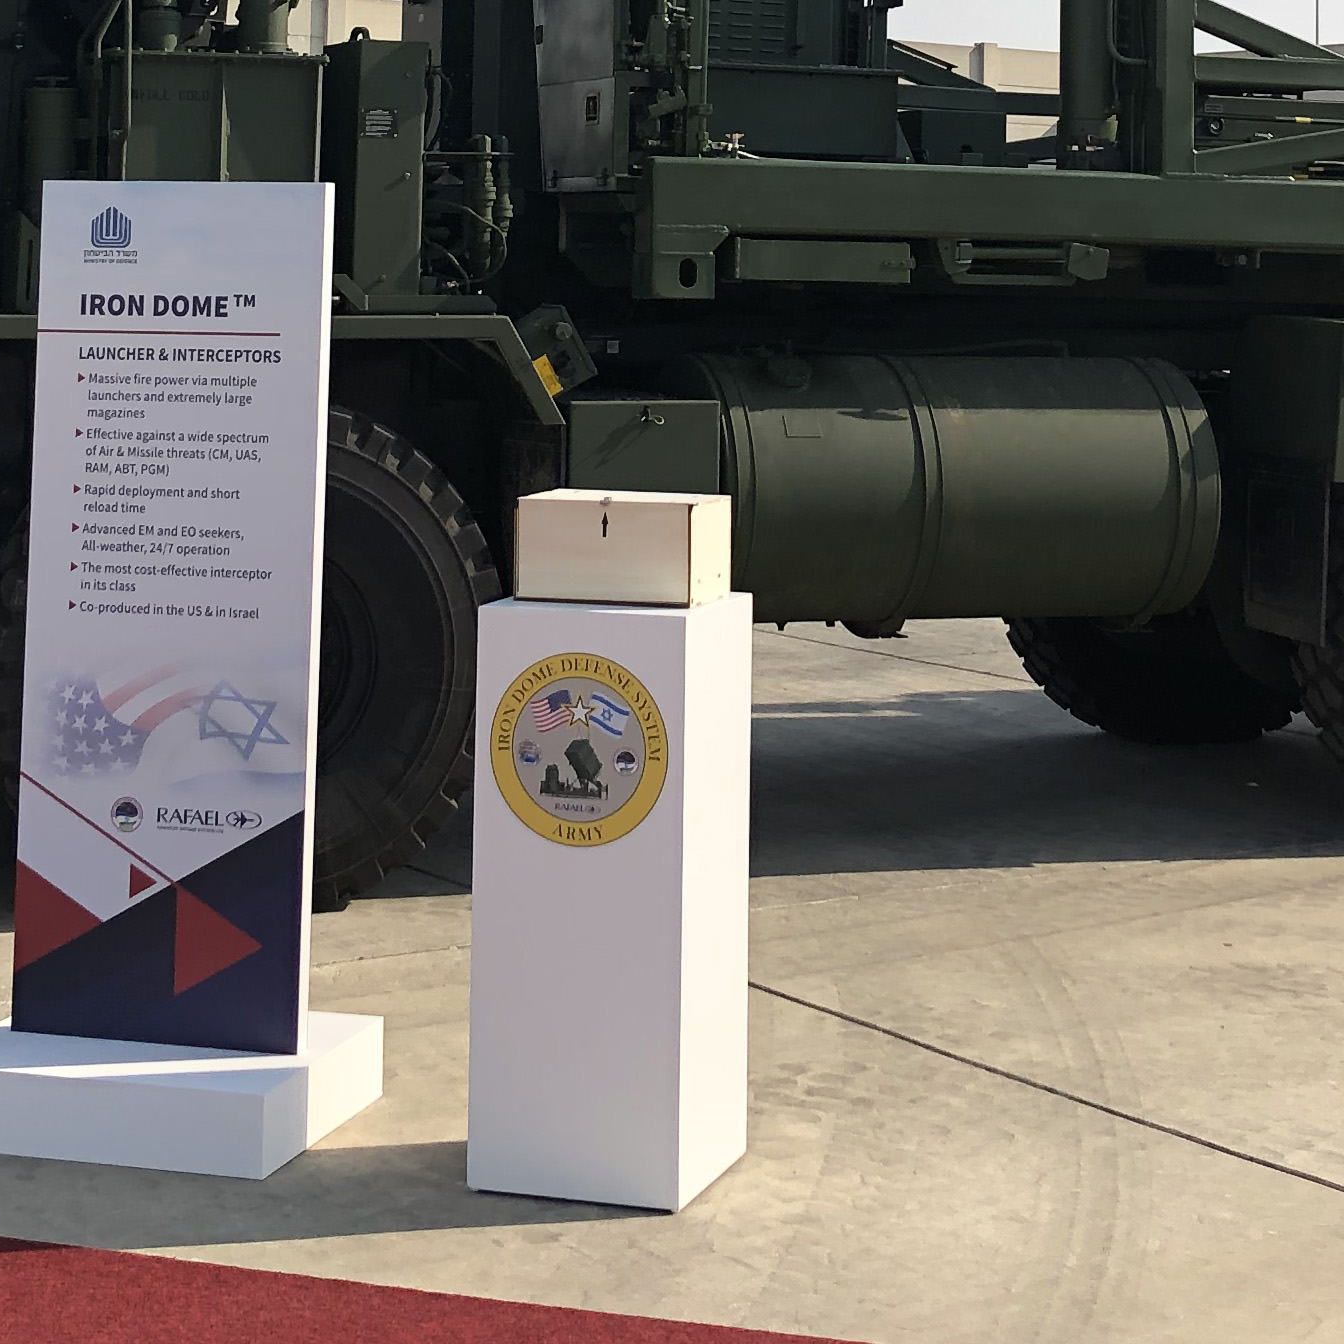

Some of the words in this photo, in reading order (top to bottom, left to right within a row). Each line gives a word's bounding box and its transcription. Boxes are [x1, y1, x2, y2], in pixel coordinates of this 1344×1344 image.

[80, 293, 145, 316] IRON
[79, 346, 155, 361] LAUNCHER
[158, 347, 169, 362] &
[172, 348, 282, 364] INTERCEPTORS
[88, 373, 131, 385] Massive
[133, 373, 152, 385] fire
[154, 377, 189, 388] power
[191, 375, 208, 386] via
[210, 375, 258, 390] multiple
[88, 390, 141, 402] launchers
[144, 391, 164, 402] and
[167, 392, 222, 405] extremely
[224, 393, 252, 407] large
[87, 408, 145, 421] magazines
[86, 428, 134, 440] Effective
[135, 429, 176, 443] against
[178, 433, 184, 441] a
[187, 430, 214, 443] wide
[216, 433, 269, 445] spectrum
[85, 444, 98, 457] of
[98, 445, 114, 457] Air
[116, 446, 125, 457] &
[127, 446, 164, 458] Missile
[166, 447, 206, 460] threats
[208, 448, 233, 462] (CM,
[235, 449, 262, 463] UAS,
[85, 462, 112, 476] RAM,
[114, 463, 138, 477] ABT,
[140, 463, 170, 477] PGM)
[84, 484, 116, 498] Rapid
[118, 485, 185, 499] deployment
[187, 487, 208, 498] and
[211, 488, 241, 500] short
[83, 501, 118, 513] reload
[120, 502, 146, 514] time
[82, 523, 136, 535] Advanced
[138, 524, 155, 536] EM
[157, 525, 178, 537] and
[181, 526, 196, 537] EO
[198, 527, 245, 541] seekers,
[81, 539, 147, 555] All-weather,
[149, 542, 174, 555] 24/7
[176, 544, 230, 557] operation
[81, 562, 102, 573] The
[105, 563, 132, 575] most
[134, 564, 208, 578] cost-effective
[210, 566, 272, 581] interceptor
[80, 580, 91, 590] in
[93, 580, 107, 591] its
[109, 580, 136, 592] class
[79, 601, 150, 615] Co-produced
[153, 604, 164, 615] in
[166, 604, 185, 615] the
[187, 605, 203, 616] US
[204, 606, 214, 617] &
[215, 607, 226, 617] in
[229, 607, 259, 619] Israel
[498, 705, 516, 752] IRON
[512, 662, 556, 703] DOME
[560, 657, 636, 691] DEFENSE
[631, 691, 661, 762] SYSTEM
[156, 807, 224, 826] RAFAEL
[553, 823, 603, 841] ARMY
